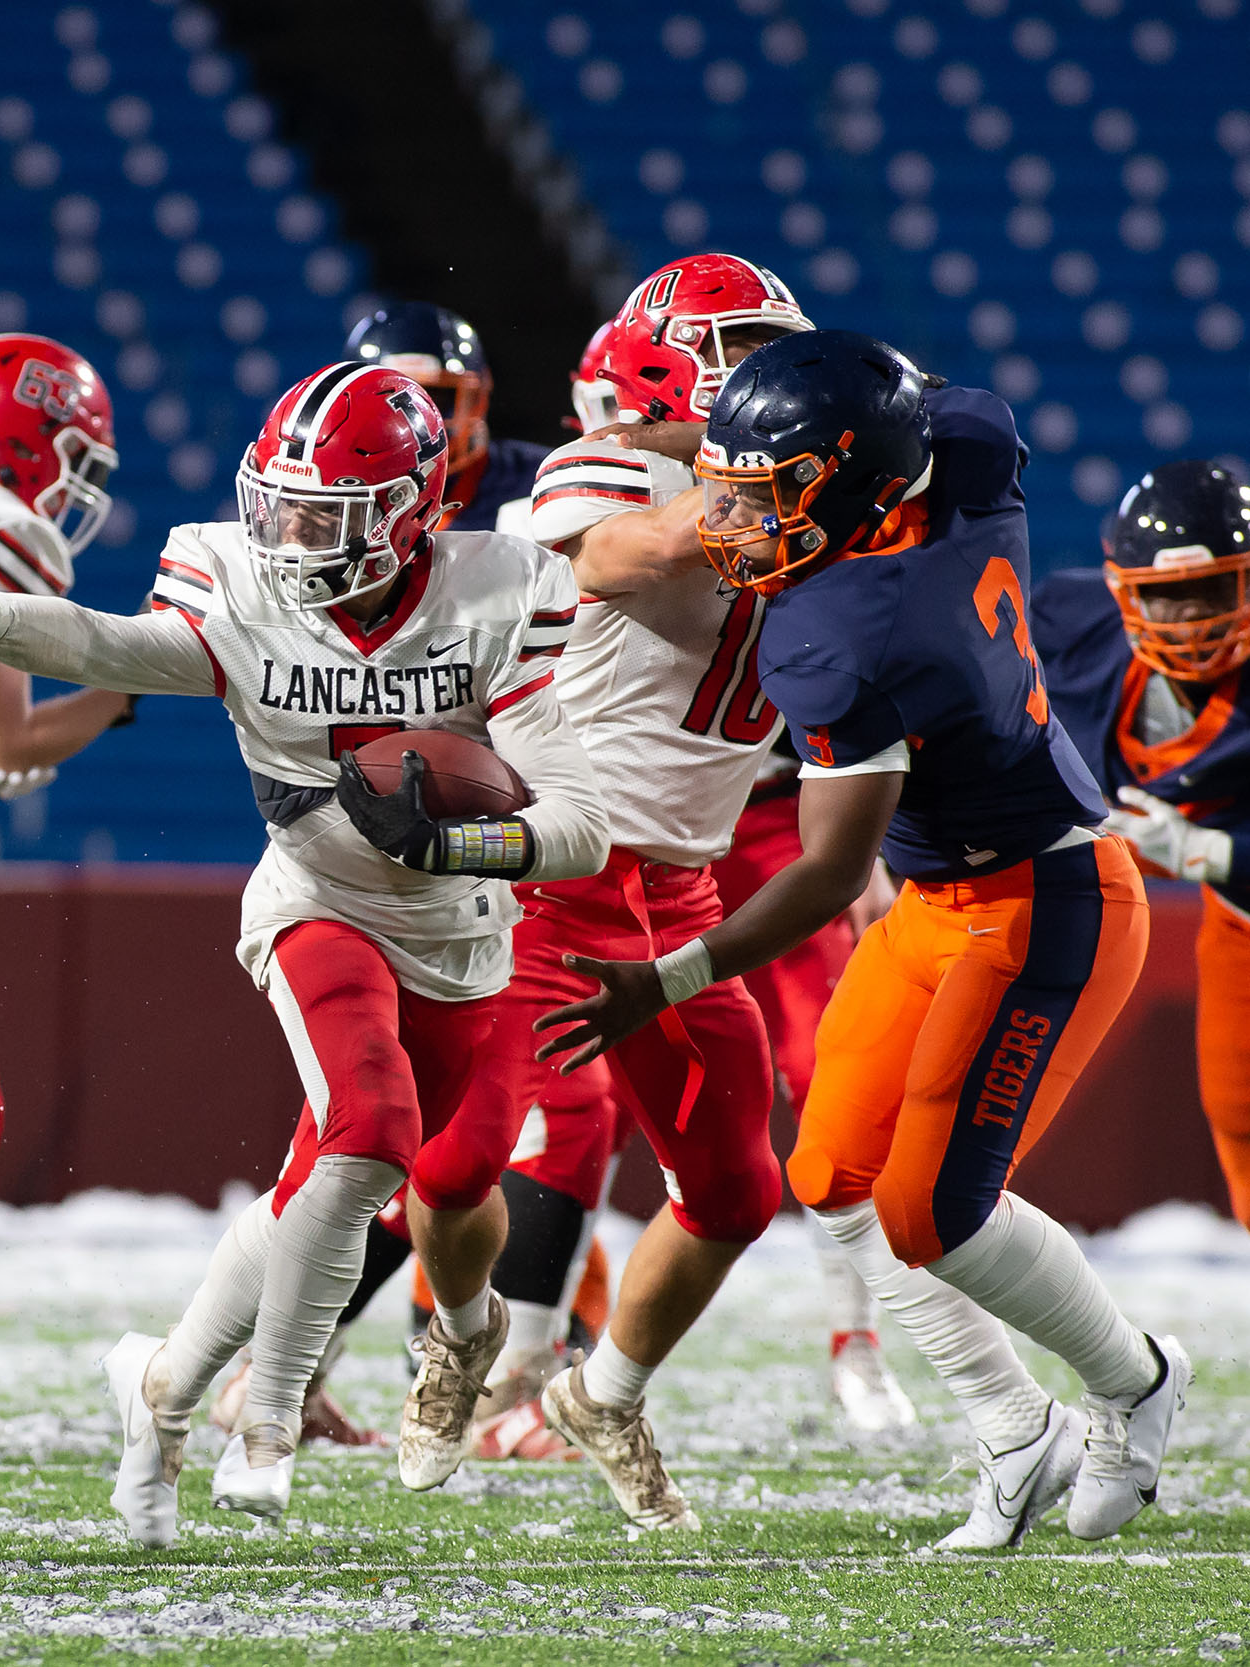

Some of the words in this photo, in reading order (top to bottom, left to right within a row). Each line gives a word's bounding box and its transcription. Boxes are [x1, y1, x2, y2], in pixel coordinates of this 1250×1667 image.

[12, 358, 81, 423] 63
[386, 386, 451, 466] L
[271, 459, 313, 477] Riddell
[972, 556, 1048, 725] 3
[258, 659, 475, 715] LANCASTER
[972, 1008, 1051, 1129] TIGERS
